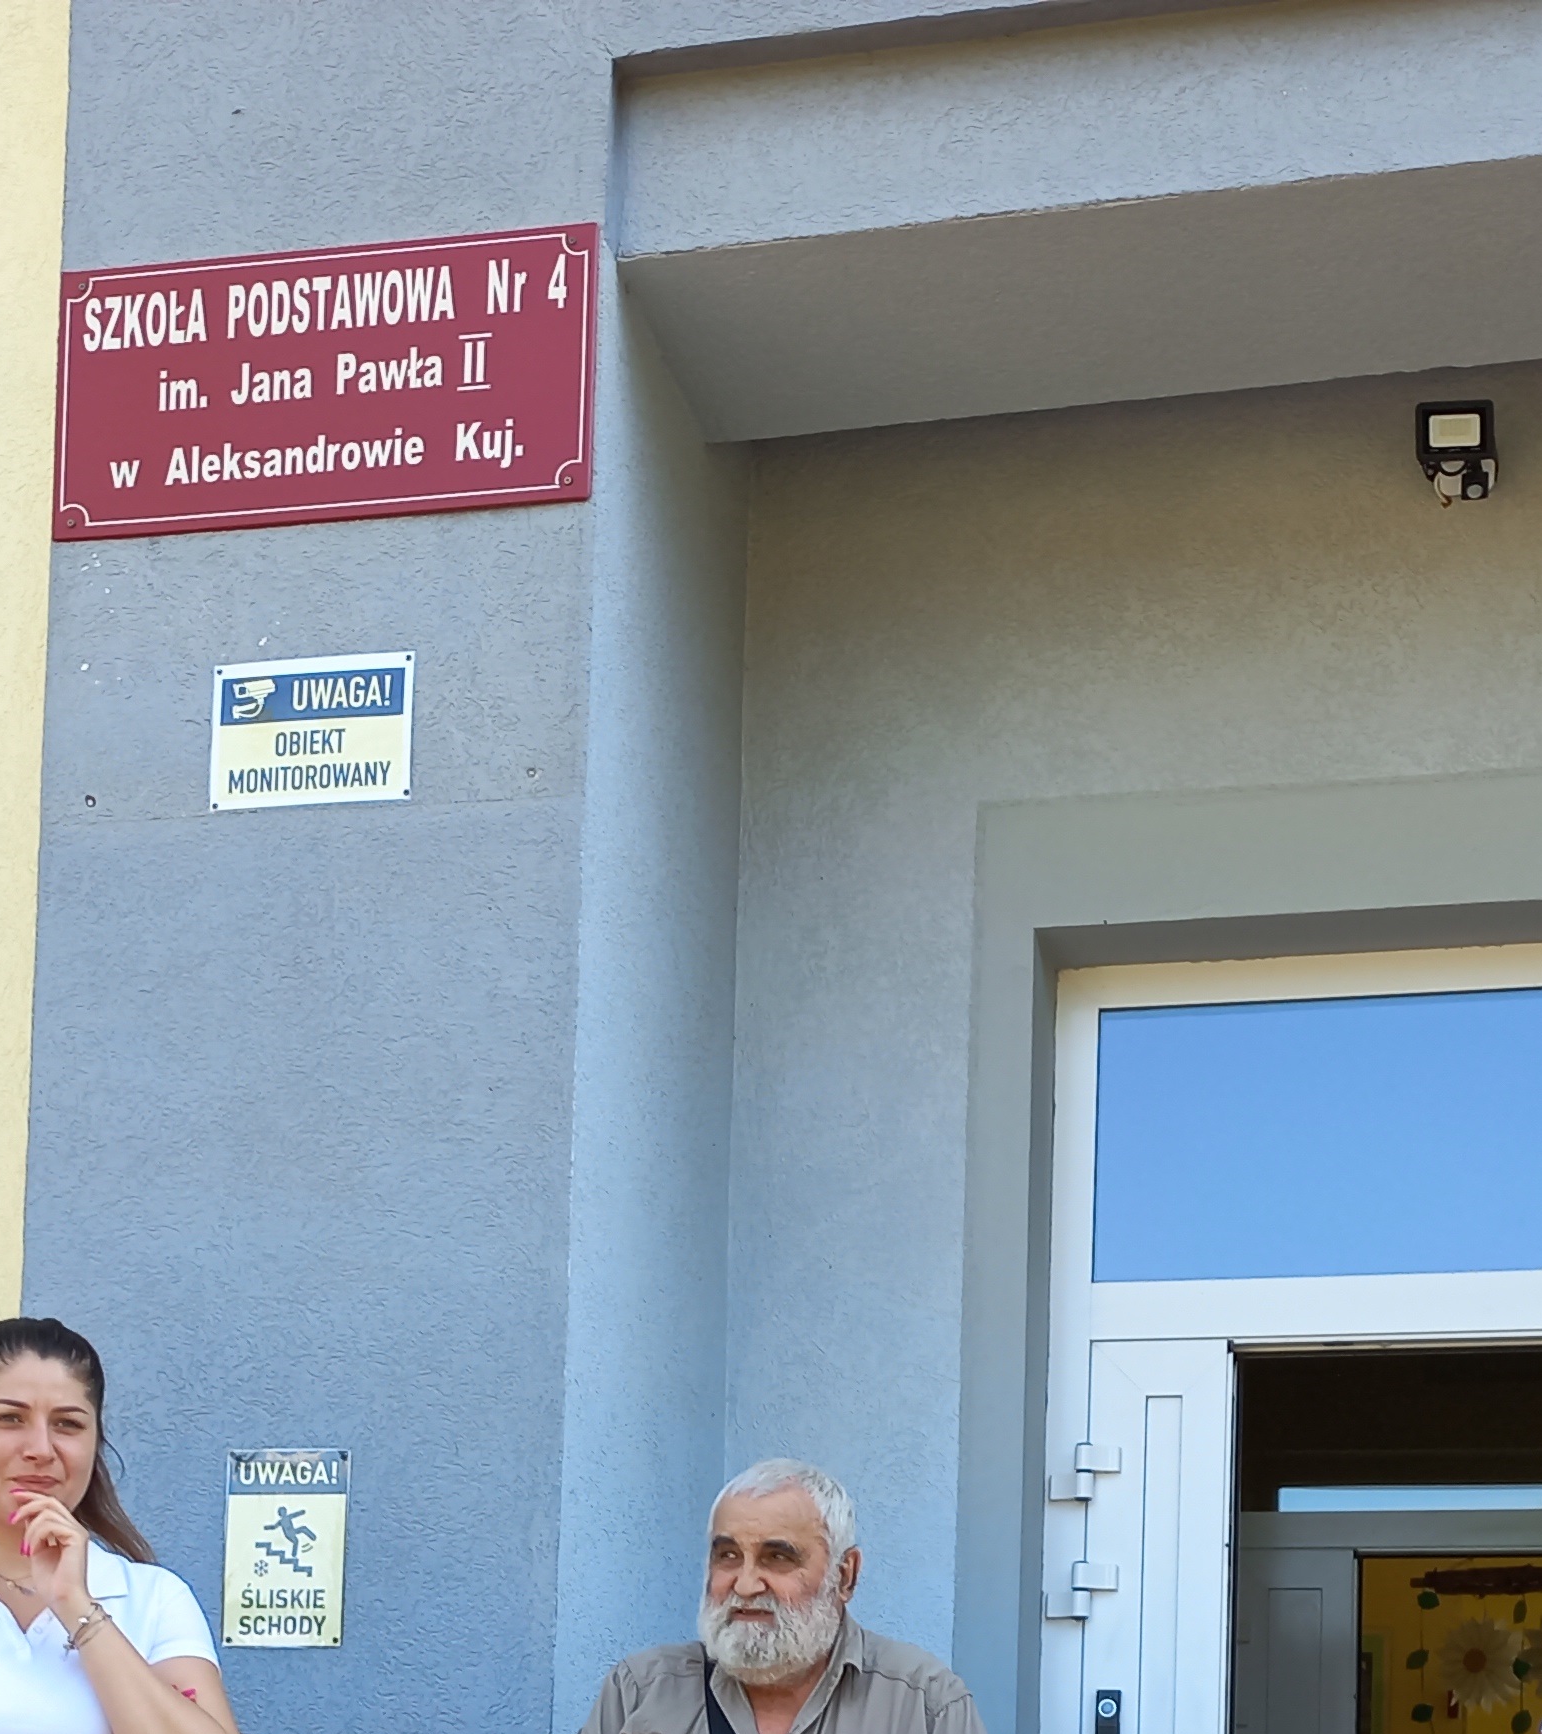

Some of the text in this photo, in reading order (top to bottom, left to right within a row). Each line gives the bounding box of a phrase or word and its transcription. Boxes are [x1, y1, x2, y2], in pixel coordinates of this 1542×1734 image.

[83, 254, 567, 351] SZKOŁA PODSTAWOWA Nr 4
[159, 333, 492, 412] im. Jana Pawła II
[110, 419, 524, 488] w Aleksandrowie Kuj.
[292, 675, 391, 712] UWAGA!
[275, 728, 346, 758] OBIEKT
[228, 761, 391, 796] MONITOROWANY
[239, 1461, 339, 1485] UWAGA!
[240, 1583, 326, 1609] ŚLISKIE
[239, 1615, 327, 1636] SCHODY
